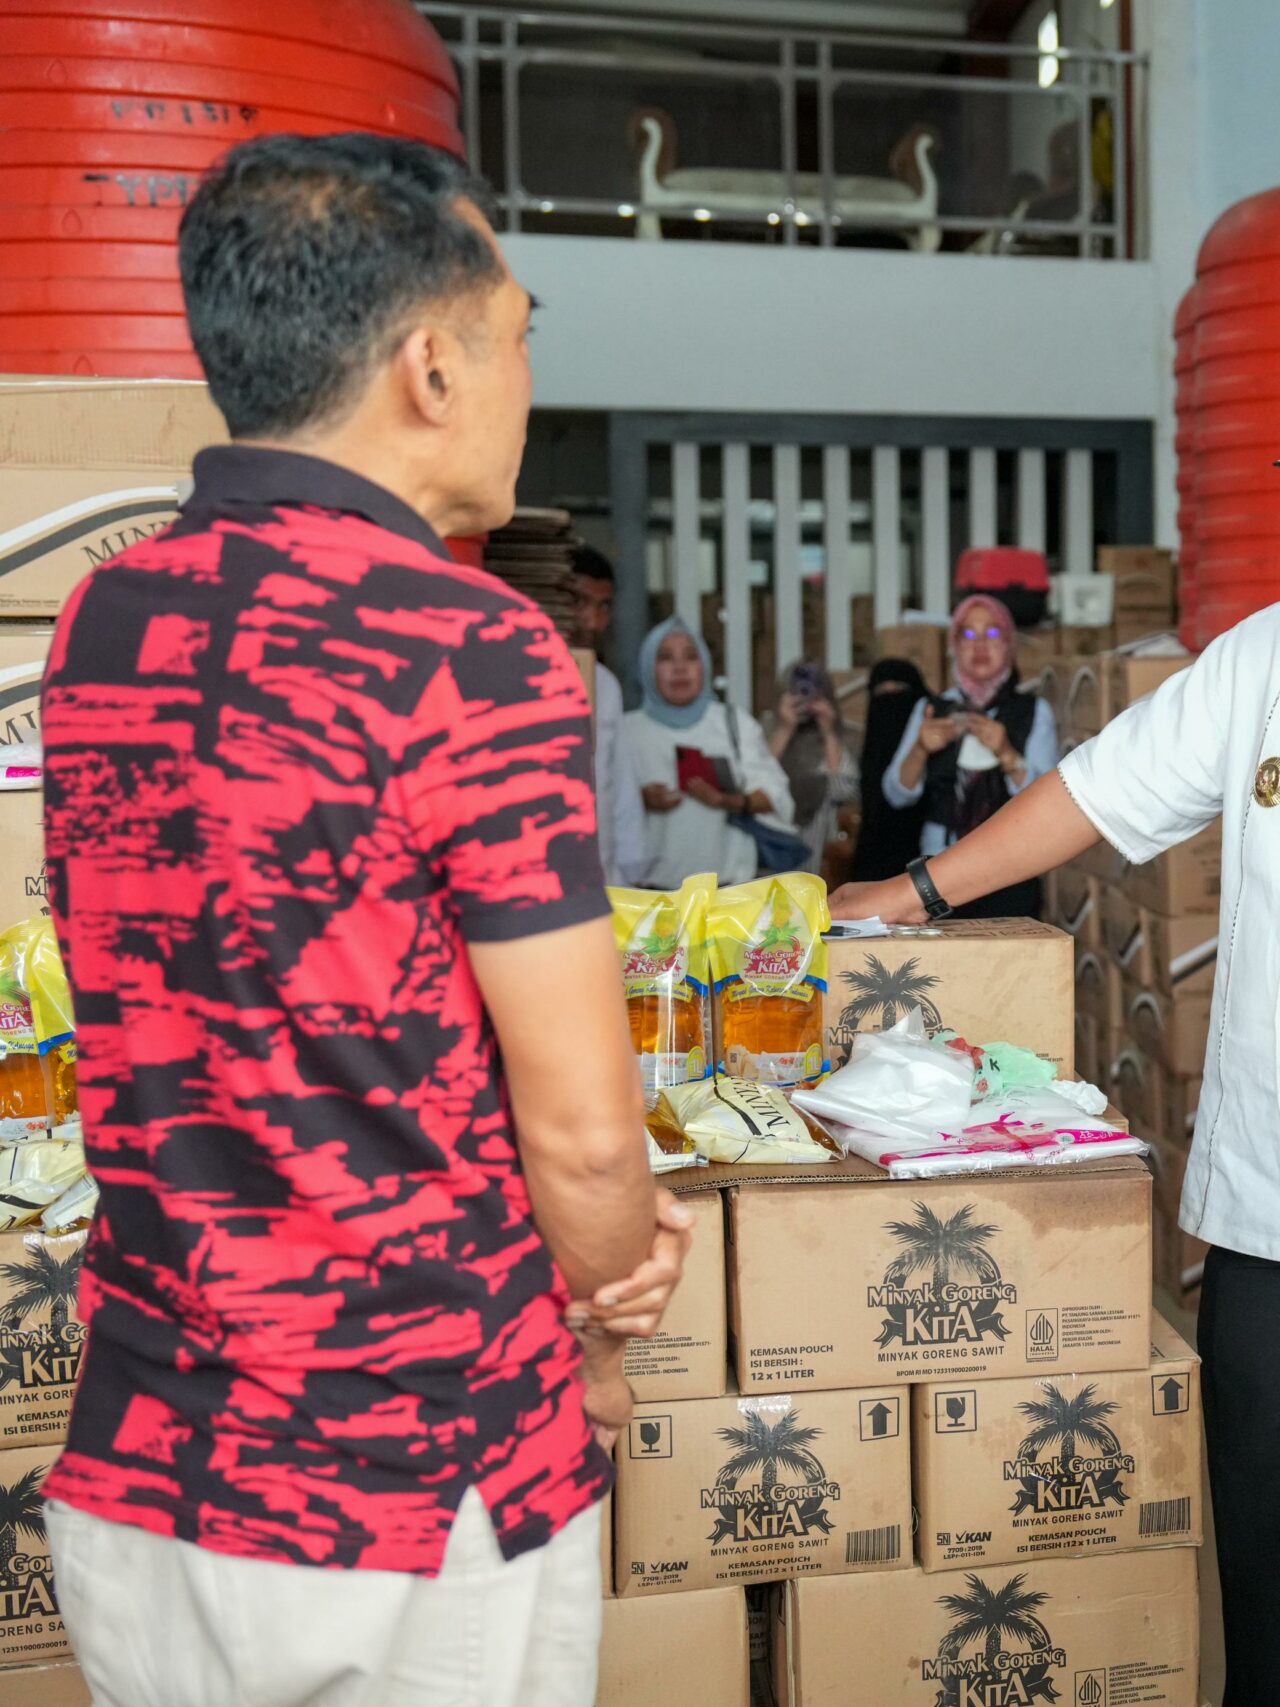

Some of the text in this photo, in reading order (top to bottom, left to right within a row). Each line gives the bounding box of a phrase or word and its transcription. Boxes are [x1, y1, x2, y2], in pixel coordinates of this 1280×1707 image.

[751, 1345, 833, 1356] KEMASAN POUCH
[878, 1346, 1004, 1361] MINYAK GORENG SAWIT
[751, 1360, 761, 1368] ISI
[764, 1359, 797, 1367] BERSIH
[751, 1372, 763, 1380] 12
[785, 1369, 814, 1378] LITER
[43, 1390, 76, 1400] GORE
[4, 1422, 60, 1435] ISI BERSIH
[1013, 1510, 1124, 1527] MINYAK GORENG SAWIT
[965, 1531, 991, 1543] KAN
[1029, 1528, 1106, 1542] KEMASAN POUCH
[711, 1538, 829, 1556] MINYAK GORENG SAWIT
[1030, 1542, 1061, 1552] BERSIH
[1092, 1536, 1117, 1544] LITER
[661, 1561, 688, 1572] KAN
[728, 1556, 810, 1569] KEMASAN POUCH
[730, 1569, 764, 1578] BERSIH
[797, 1563, 822, 1571] LITER
[0, 1574, 59, 1619] iTA
[0, 1623, 43, 1638] ORENG
